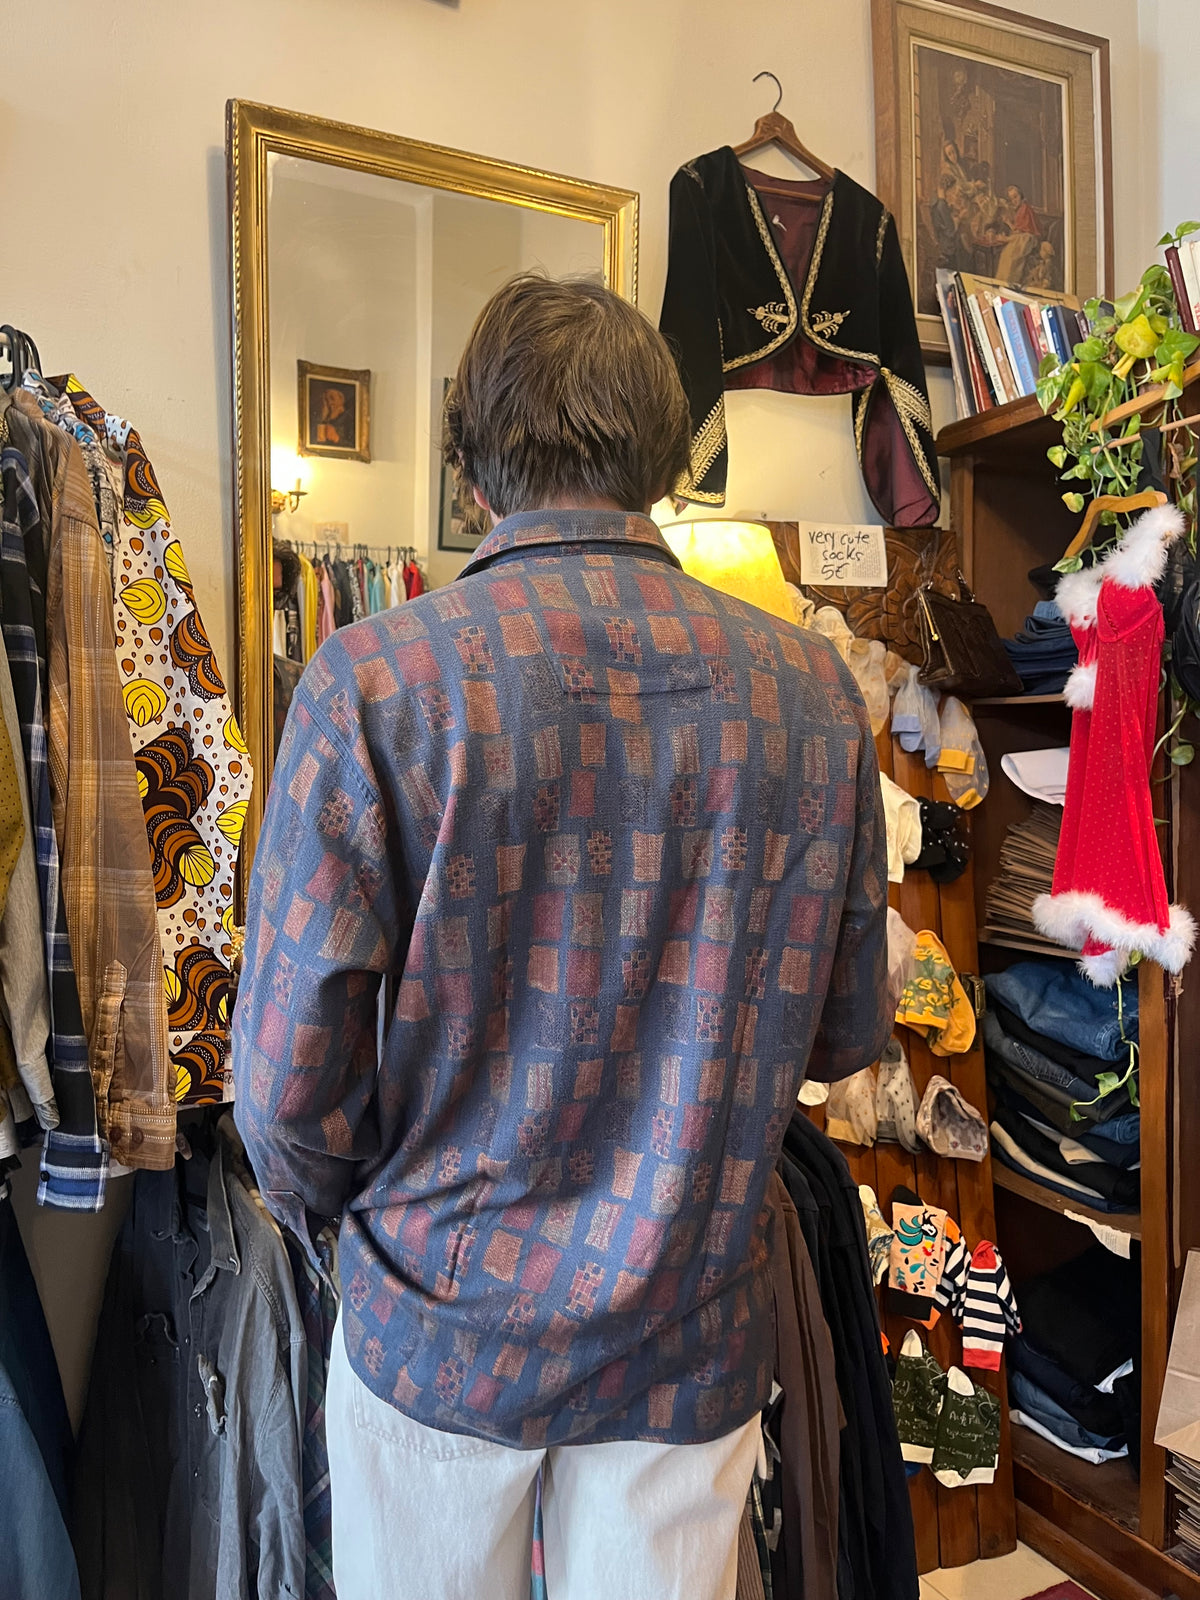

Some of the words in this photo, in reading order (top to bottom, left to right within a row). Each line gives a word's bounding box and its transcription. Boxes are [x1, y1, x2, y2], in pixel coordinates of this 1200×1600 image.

[808, 531, 835, 550] very
[840, 531, 870, 546] cute
[822, 545, 864, 561] socks
[821, 563, 850, 580] 5€
